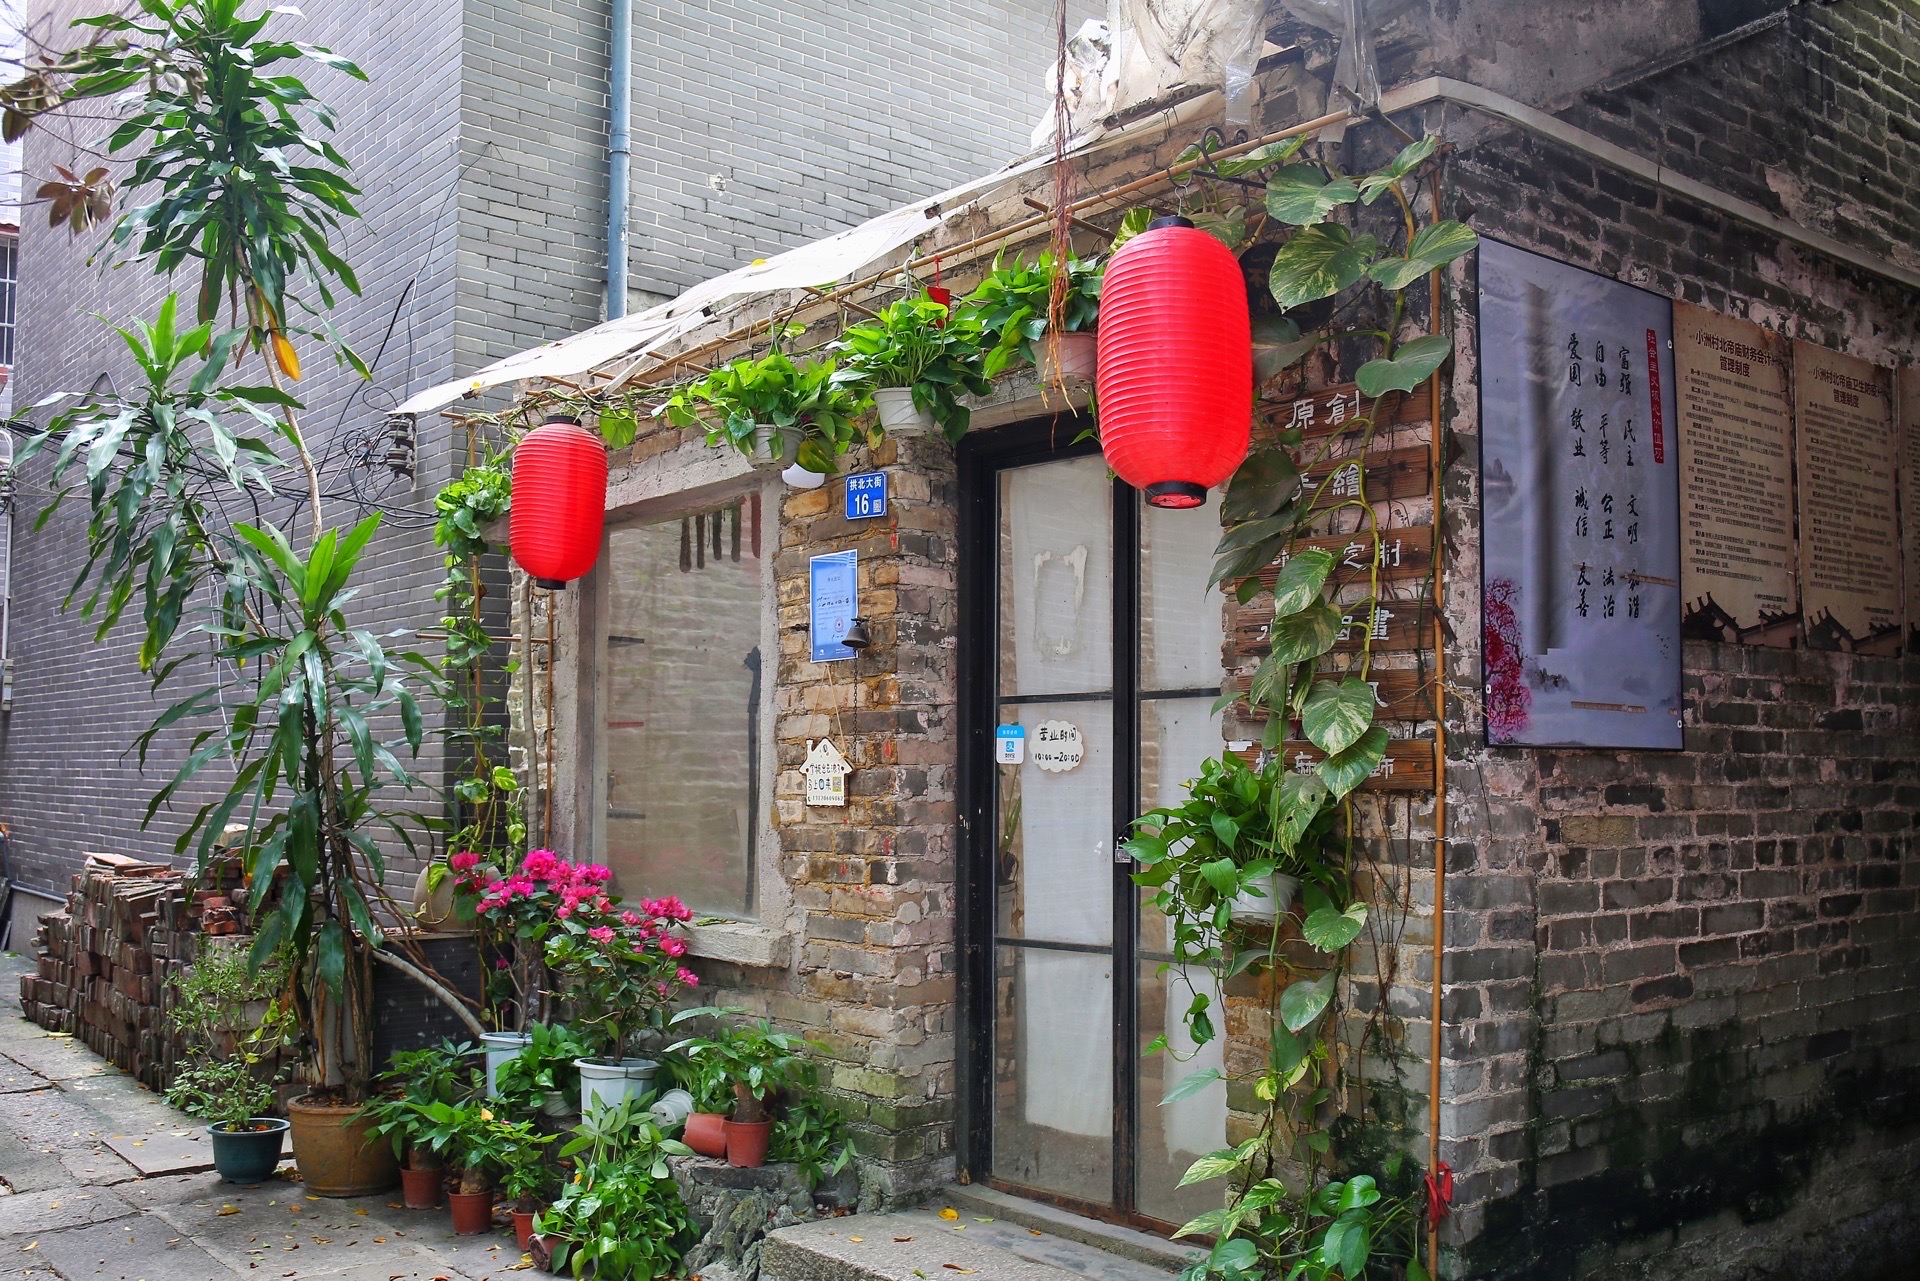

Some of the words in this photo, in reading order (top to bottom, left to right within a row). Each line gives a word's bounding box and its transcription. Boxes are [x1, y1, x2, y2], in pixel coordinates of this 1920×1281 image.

[1568, 332, 1582, 387] 爱国
[1595, 340, 1607, 388] 自由
[1618, 346, 1632, 395] 富强
[1696, 329, 1772, 366] 小洲村北帝庙财务会计
[1720, 355, 1750, 377] 管理制度
[1285, 390, 1361, 429] 原創
[1570, 407, 1586, 457] 敬业
[1598, 413, 1610, 464] 平等
[1624, 419, 1637, 467] 民主
[850, 476, 882, 491] 拱北大街
[855, 493, 869, 515] 16
[1601, 493, 1615, 540] 公正
[1627, 494, 1639, 544] 文明
[1575, 562, 1591, 618] 友善
[1602, 566, 1615, 619] 法治
[1039, 727, 1077, 742] 营业时间
